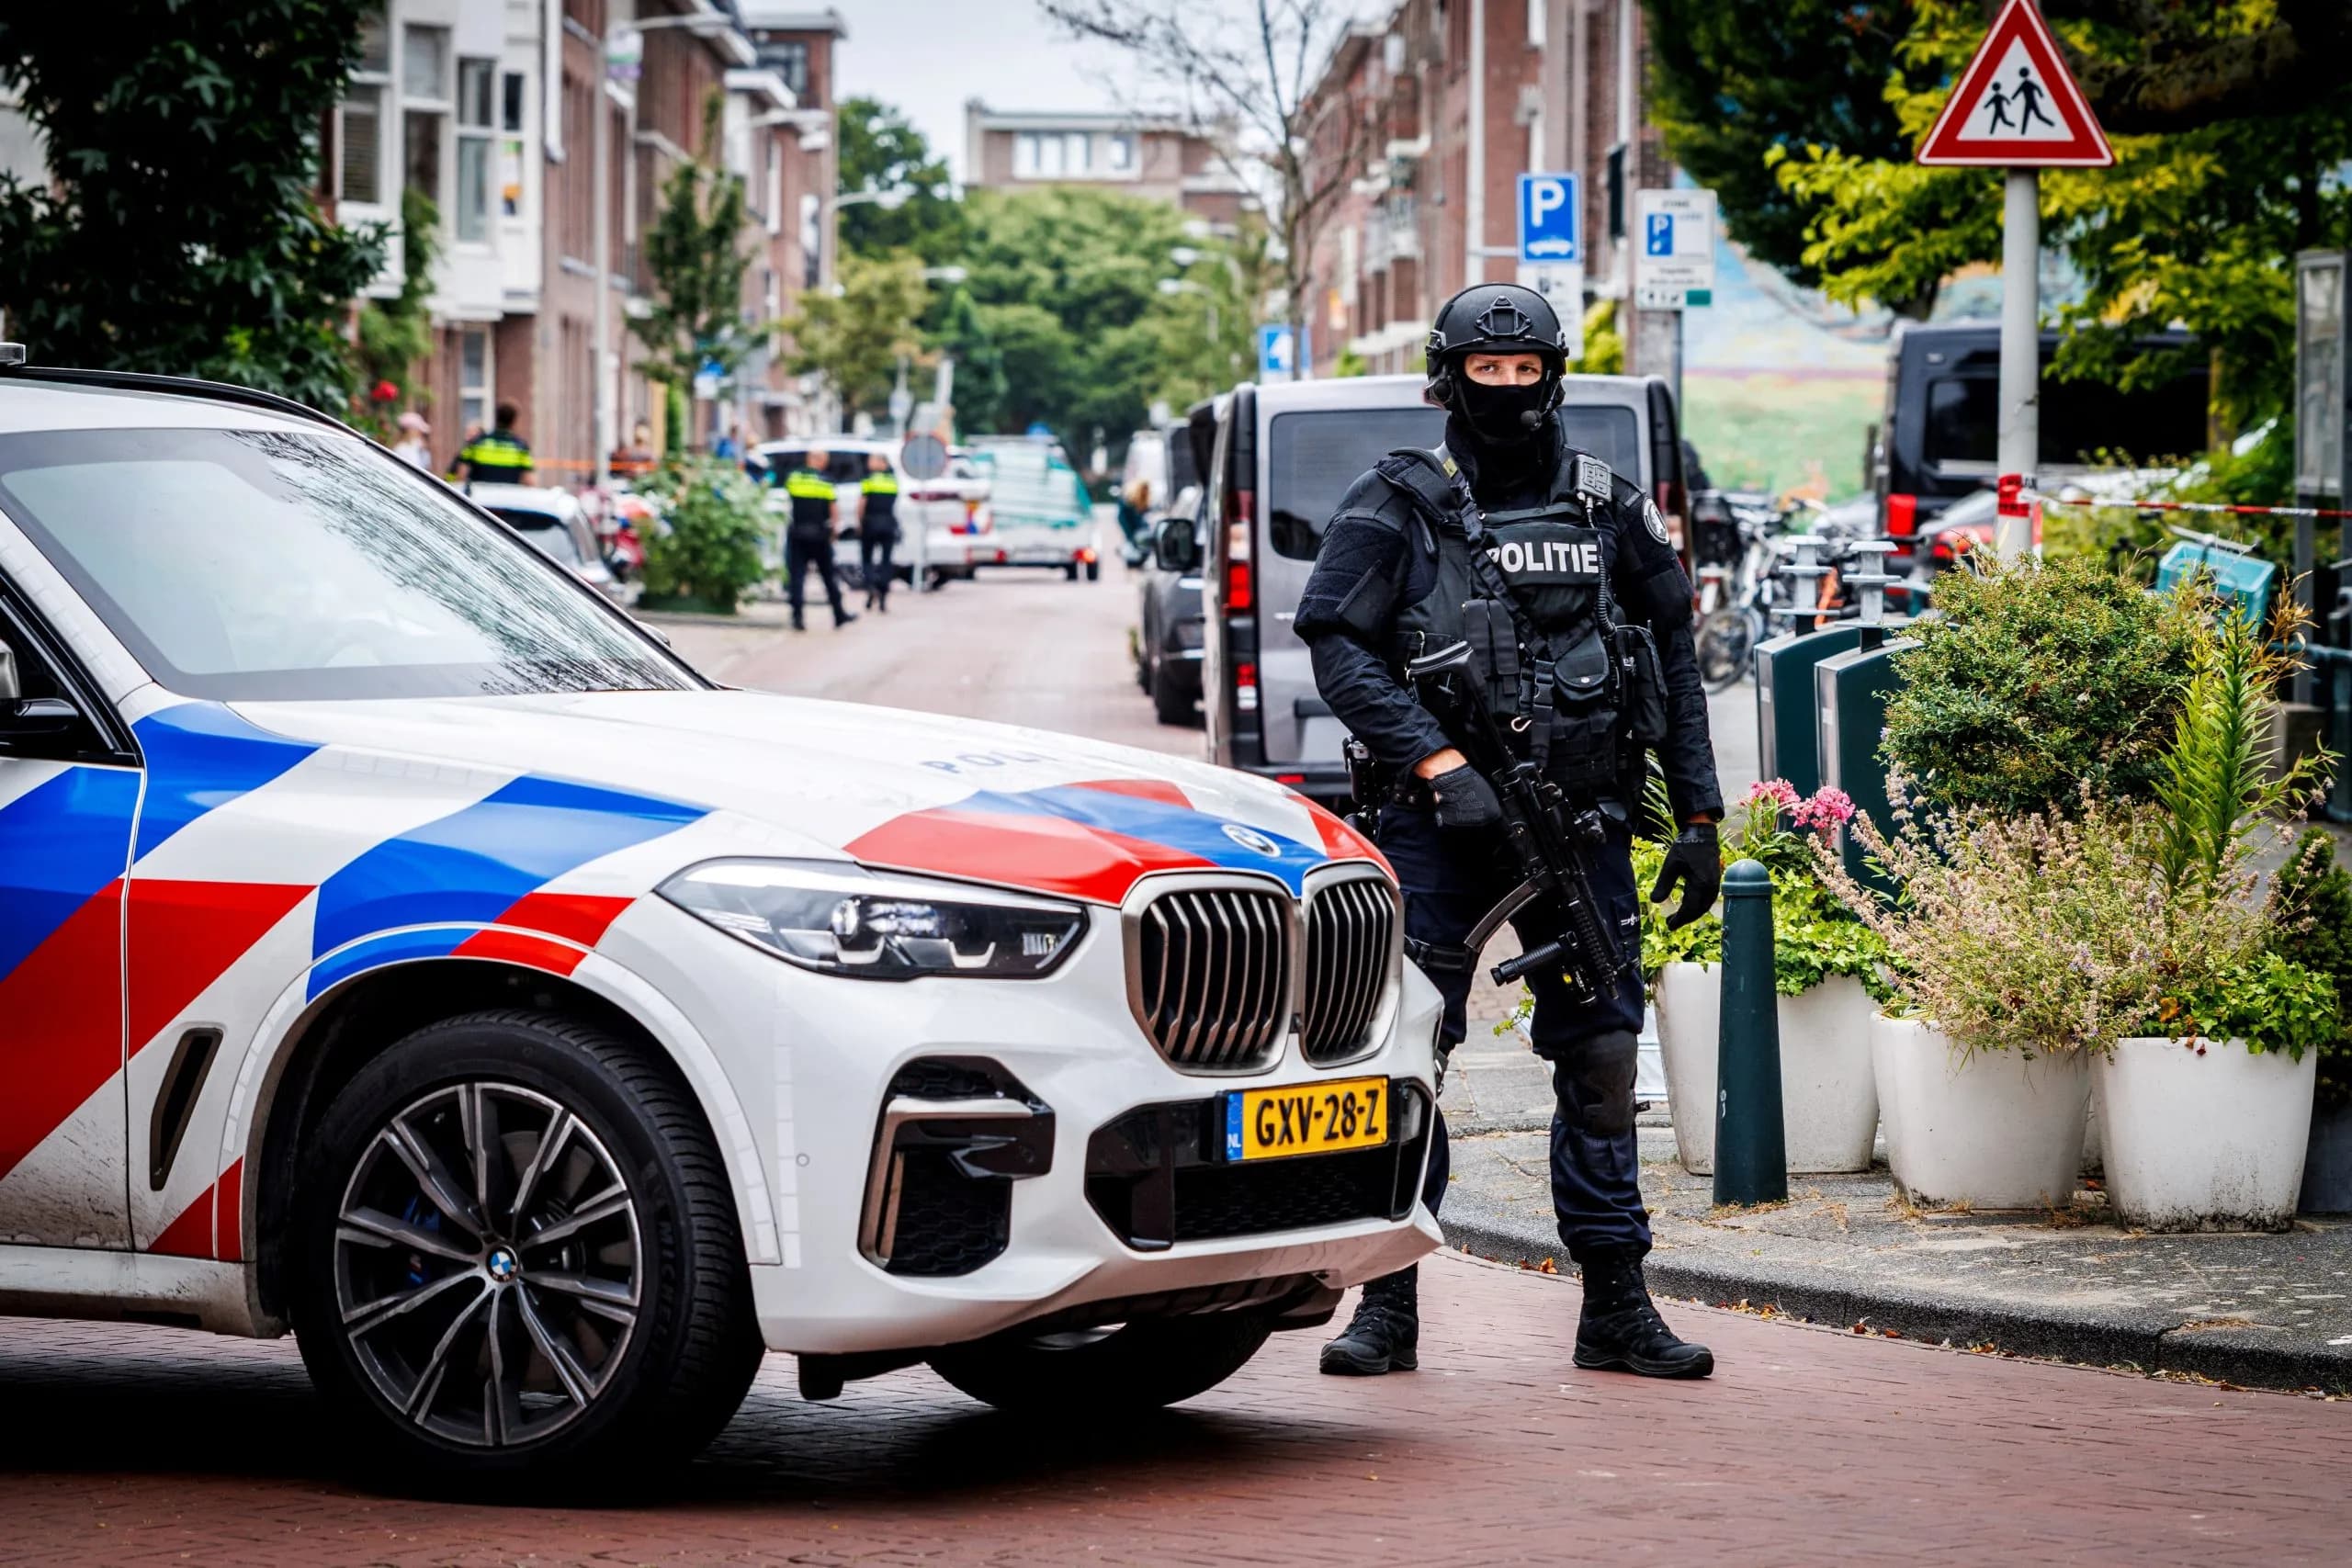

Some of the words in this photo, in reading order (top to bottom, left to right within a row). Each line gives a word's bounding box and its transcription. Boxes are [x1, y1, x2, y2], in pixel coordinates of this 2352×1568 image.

[1531, 181, 1566, 227] P
[1653, 215, 1668, 236] P
[1256, 1089, 1378, 1145] GXV-28-Z
[1227, 1134, 1241, 1147] NL
